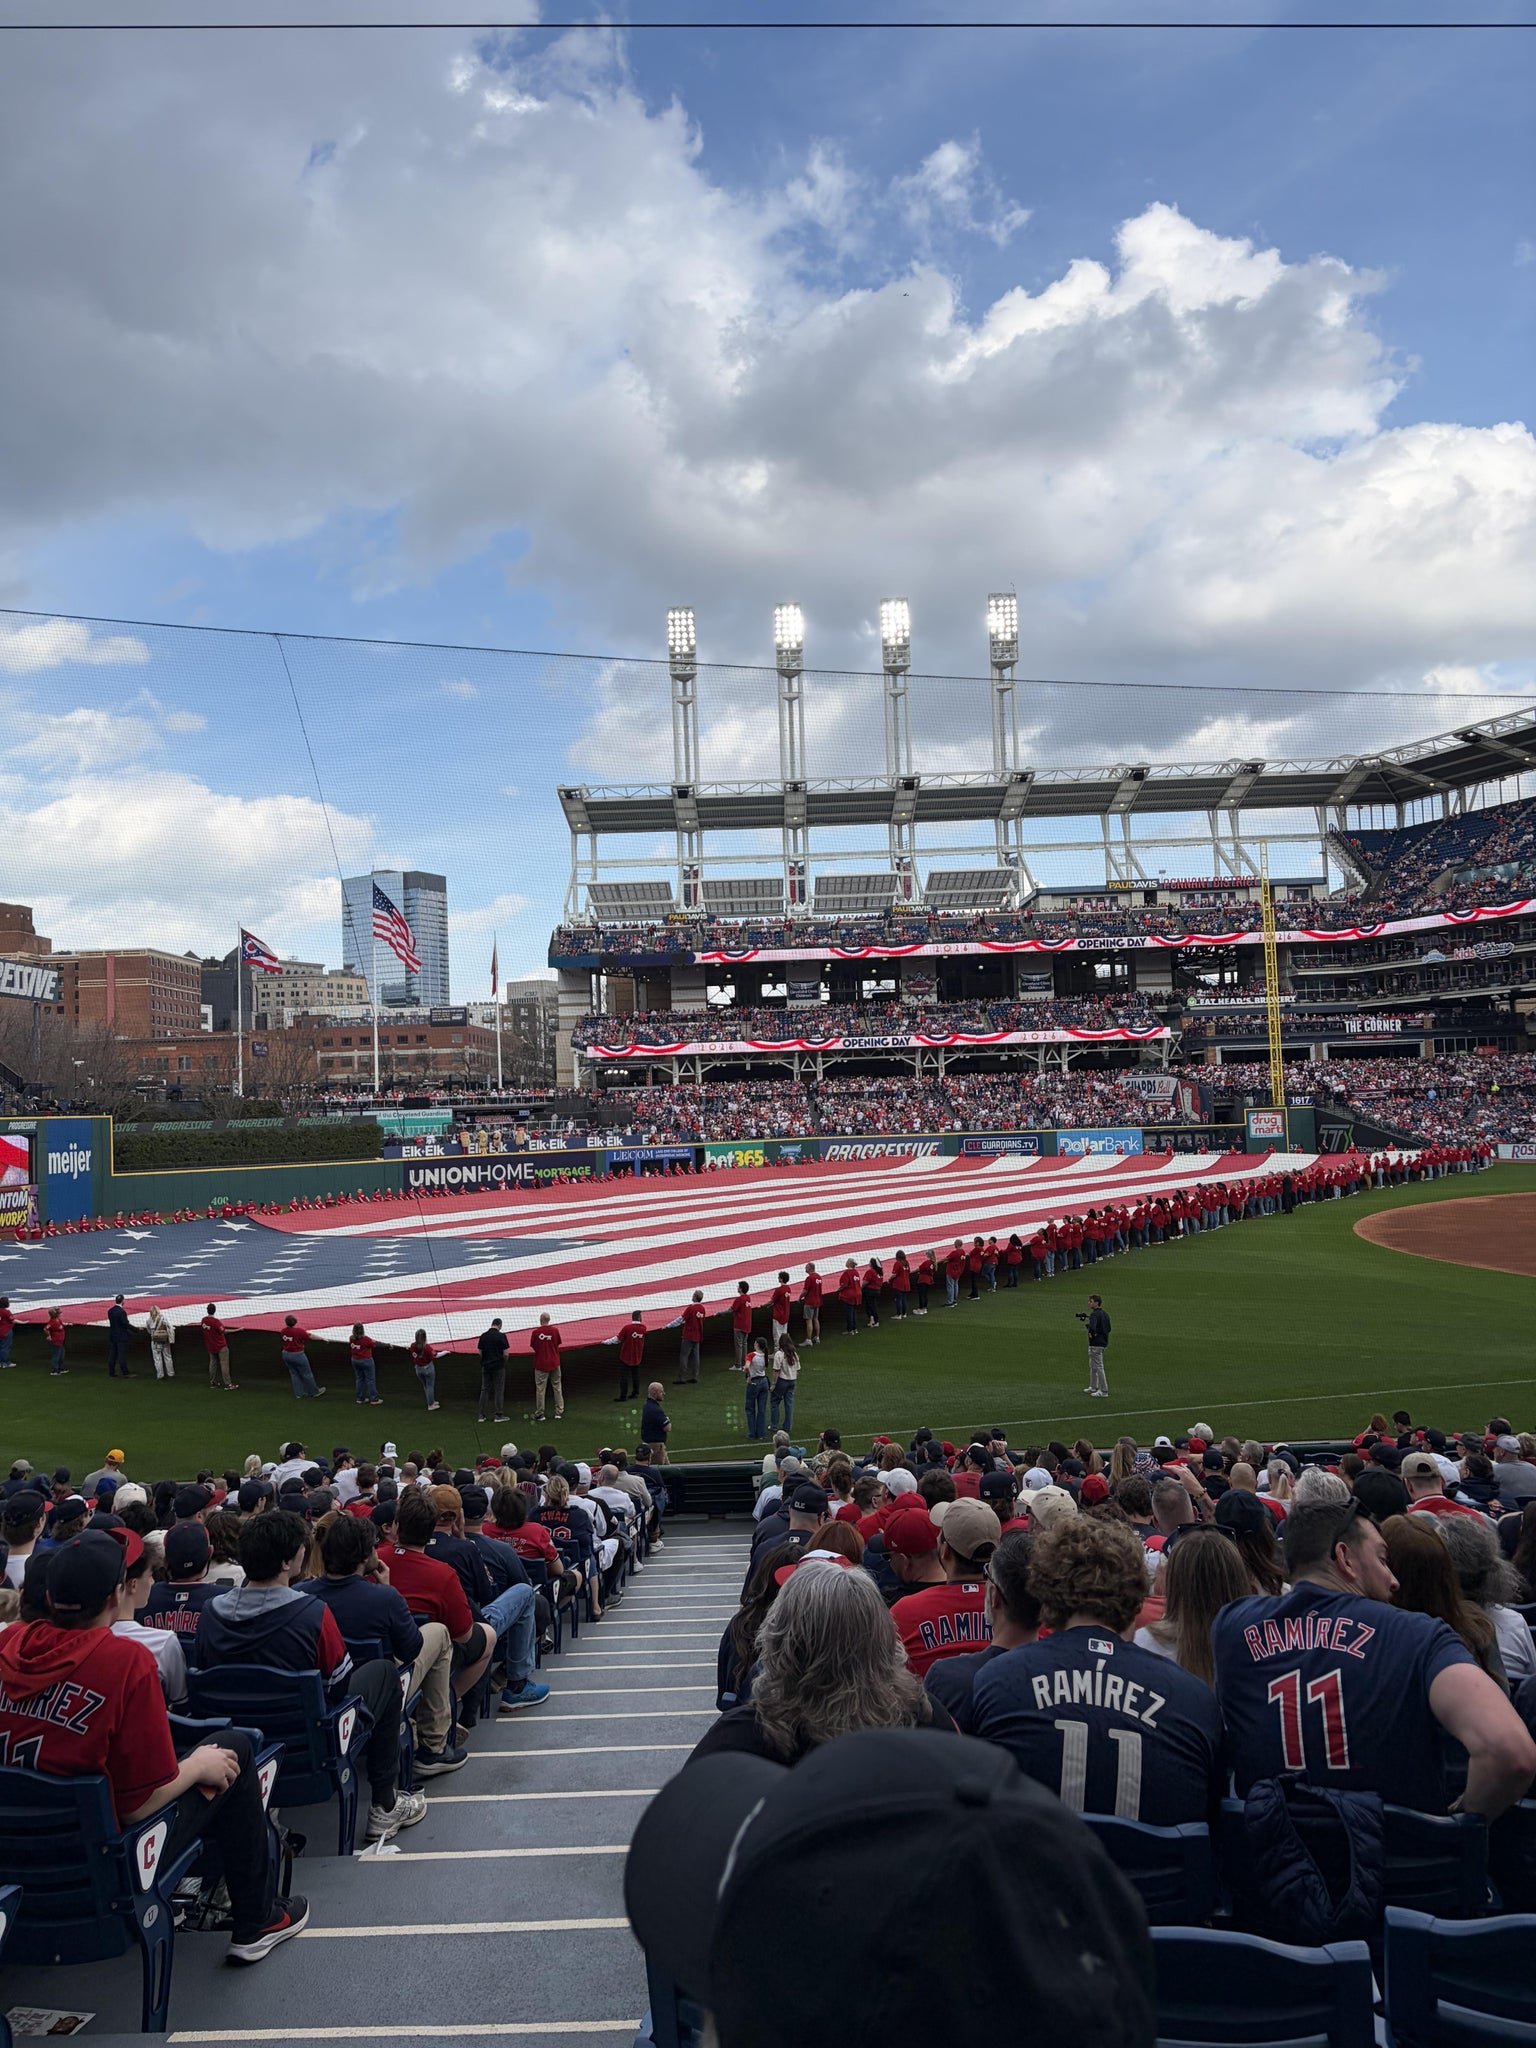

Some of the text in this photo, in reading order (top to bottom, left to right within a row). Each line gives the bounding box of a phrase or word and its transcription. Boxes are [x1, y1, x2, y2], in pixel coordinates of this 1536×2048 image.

[1213, 875, 1258, 888] DISTRICT
[1078, 938, 1147, 948] OPENING DAY
[1454, 947, 1476, 960] kids
[1344, 1020, 1362, 1033] THE
[1364, 1019, 1402, 1032] CORNER
[842, 1036, 911, 1048] OPENING DAY
[1291, 1096, 1309, 1105] 1617
[421, 1108, 450, 1117] Guardians
[226, 1117, 285, 1128] PROGRESSIVE
[297, 1115, 352, 1126] PROGRESSIVE
[1252, 1112, 1277, 1126] drug
[152, 1120, 214, 1131] PROGRESSIVE
[1255, 1126, 1283, 1134] mart
[1512, 1144, 1536, 1158] ROS
[48, 1143, 91, 1180] meijer
[705, 1149, 764, 1168] bet365
[534, 1166, 591, 1178] MORTGAGE
[210, 1197, 229, 1206] 400
[540, 1512, 570, 1523] KWAN
[1244, 1610, 1376, 1662] RAMÍREZ
[1031, 1659, 1166, 1728] RAMÍREZ
[1267, 1668, 1350, 1770] 11
[1054, 1719, 1142, 1822] 11
